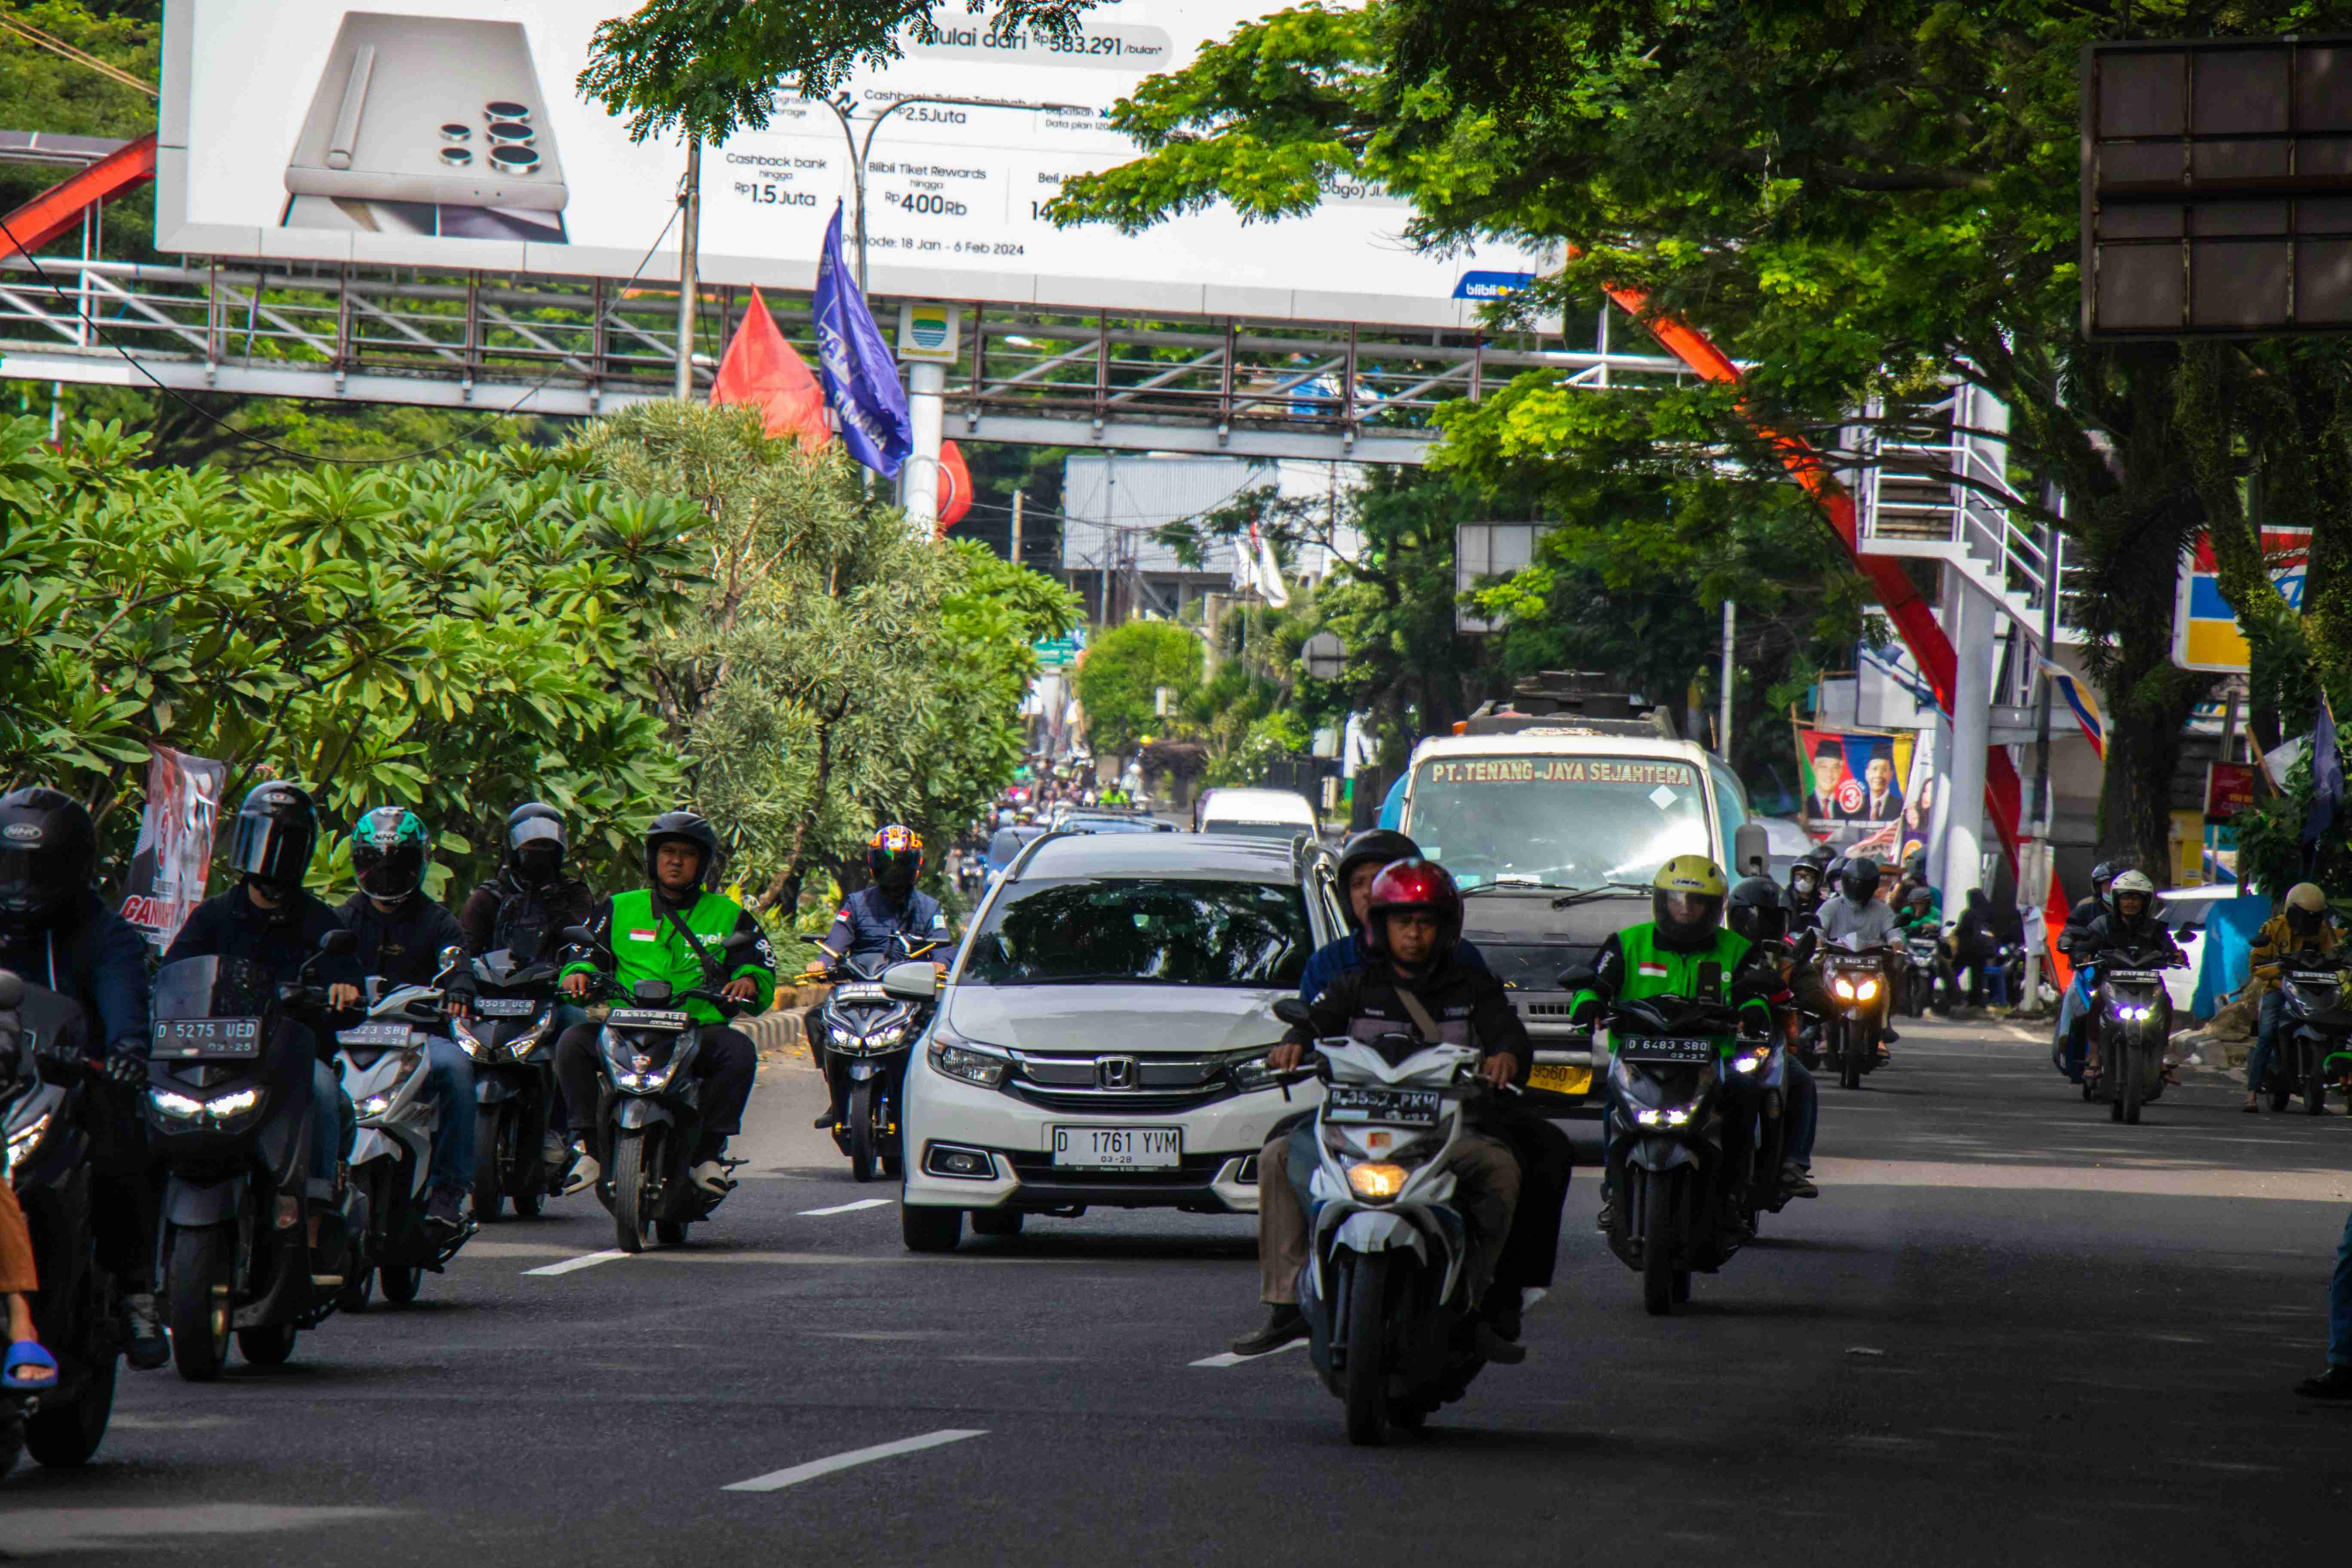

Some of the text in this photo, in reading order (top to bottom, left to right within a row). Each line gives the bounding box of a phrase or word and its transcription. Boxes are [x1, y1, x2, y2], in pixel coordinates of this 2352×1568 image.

[982, 30, 1027, 49] dari
[1045, 119, 1069, 128] Data
[1071, 122, 1092, 132] plan
[726, 153, 827, 169] Cashback bank
[759, 169, 793, 181] hingga
[869, 162, 987, 180] Blibli Tiket Rewards
[1038, 173, 1060, 184] Beli
[910, 179, 944, 190] hingga
[778, 191, 816, 206] Juta
[901, 236, 913, 249] 18
[916, 239, 941, 251] Jan
[954, 242, 962, 253] 6
[965, 242, 989, 254] Feb
[993, 243, 1024, 256] 2024
[1466, 283, 1497, 296] blibli
[1589, 763, 1692, 786] SEJAHTERA
[1844, 788, 1858, 806] 3
[157, 1023, 255, 1038] D 5275 UED
[1629, 1040, 1636, 1049] D
[1643, 1040, 1675, 1050] 6483
[1057, 1131, 1177, 1154] D 1761 YVM
